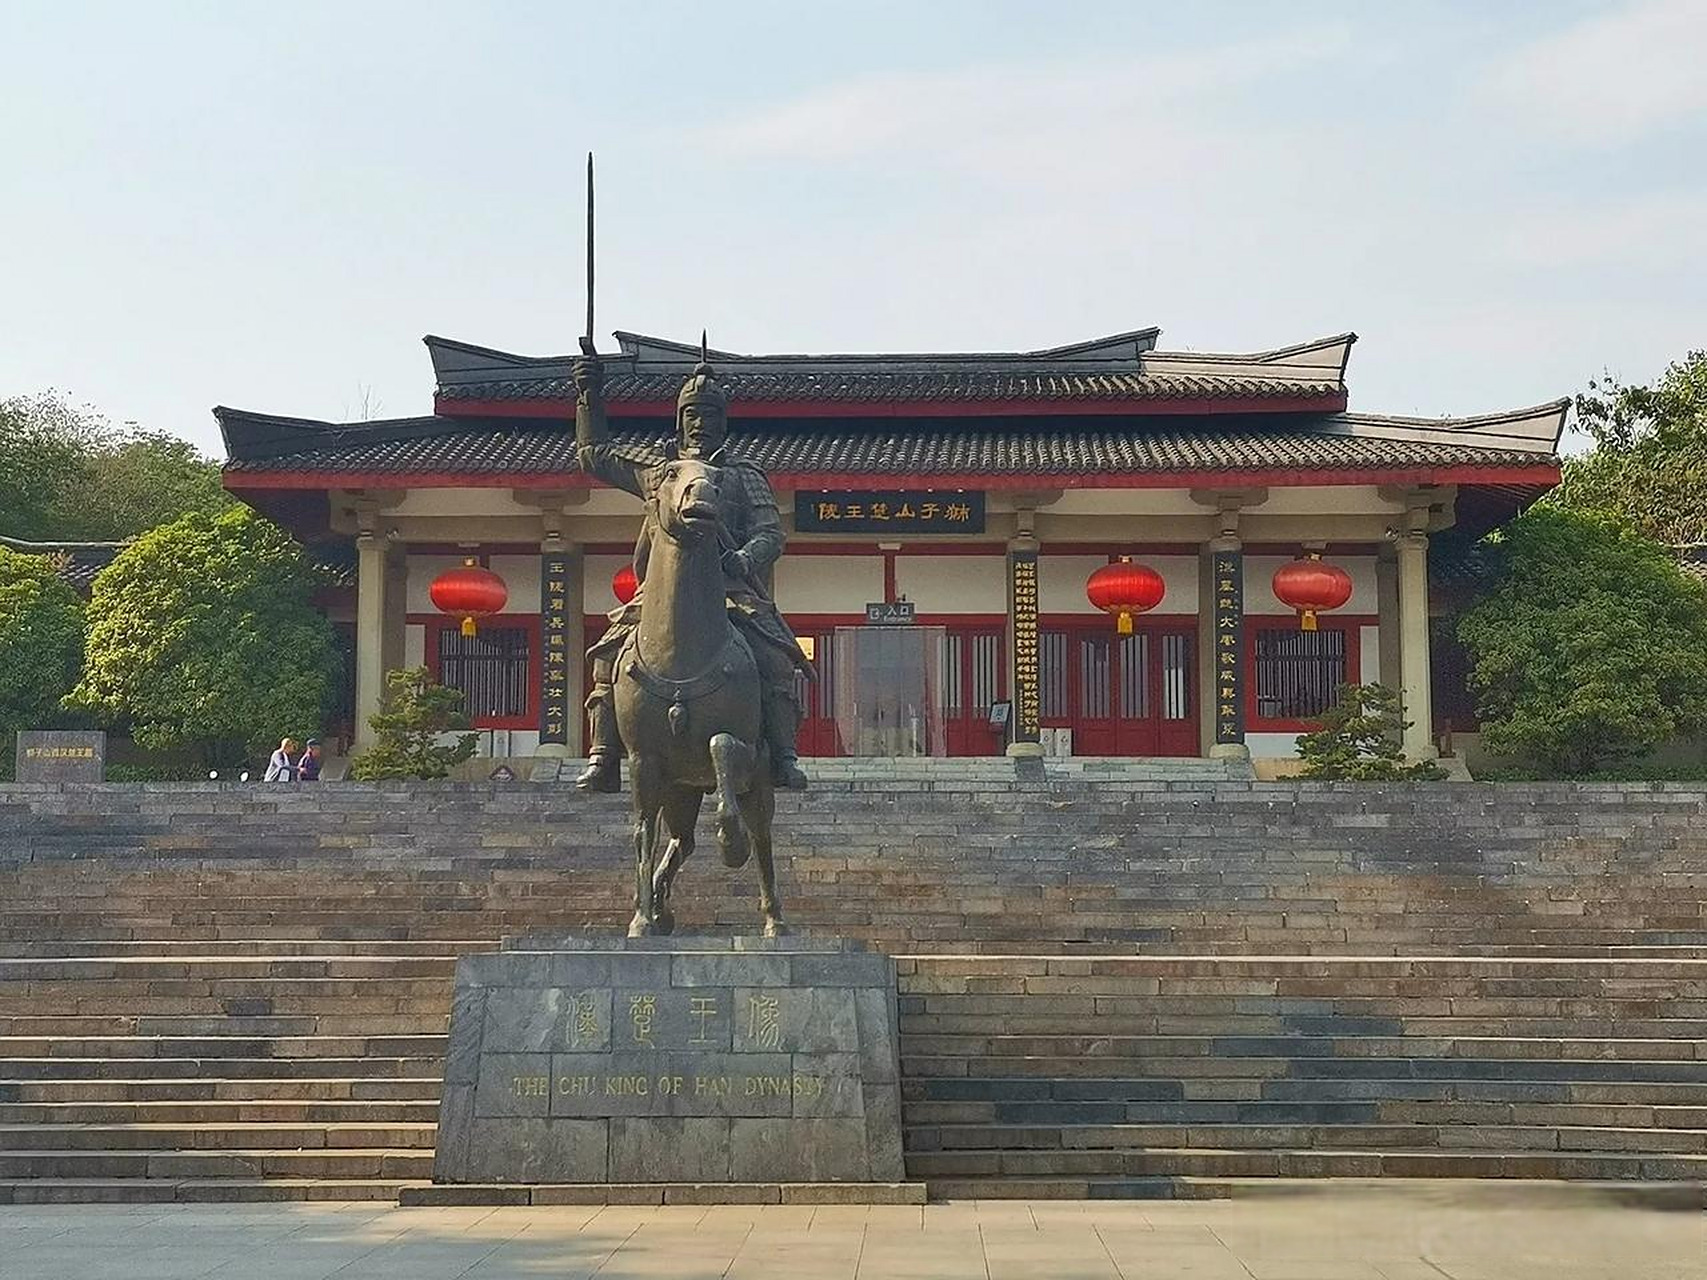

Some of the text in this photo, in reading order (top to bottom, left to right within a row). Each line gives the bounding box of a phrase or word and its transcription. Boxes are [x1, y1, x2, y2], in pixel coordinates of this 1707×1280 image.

[886, 605, 909, 616] 入口
[512, 1076, 826, 1097] THE CHU KING OF HAN DYNASTY
